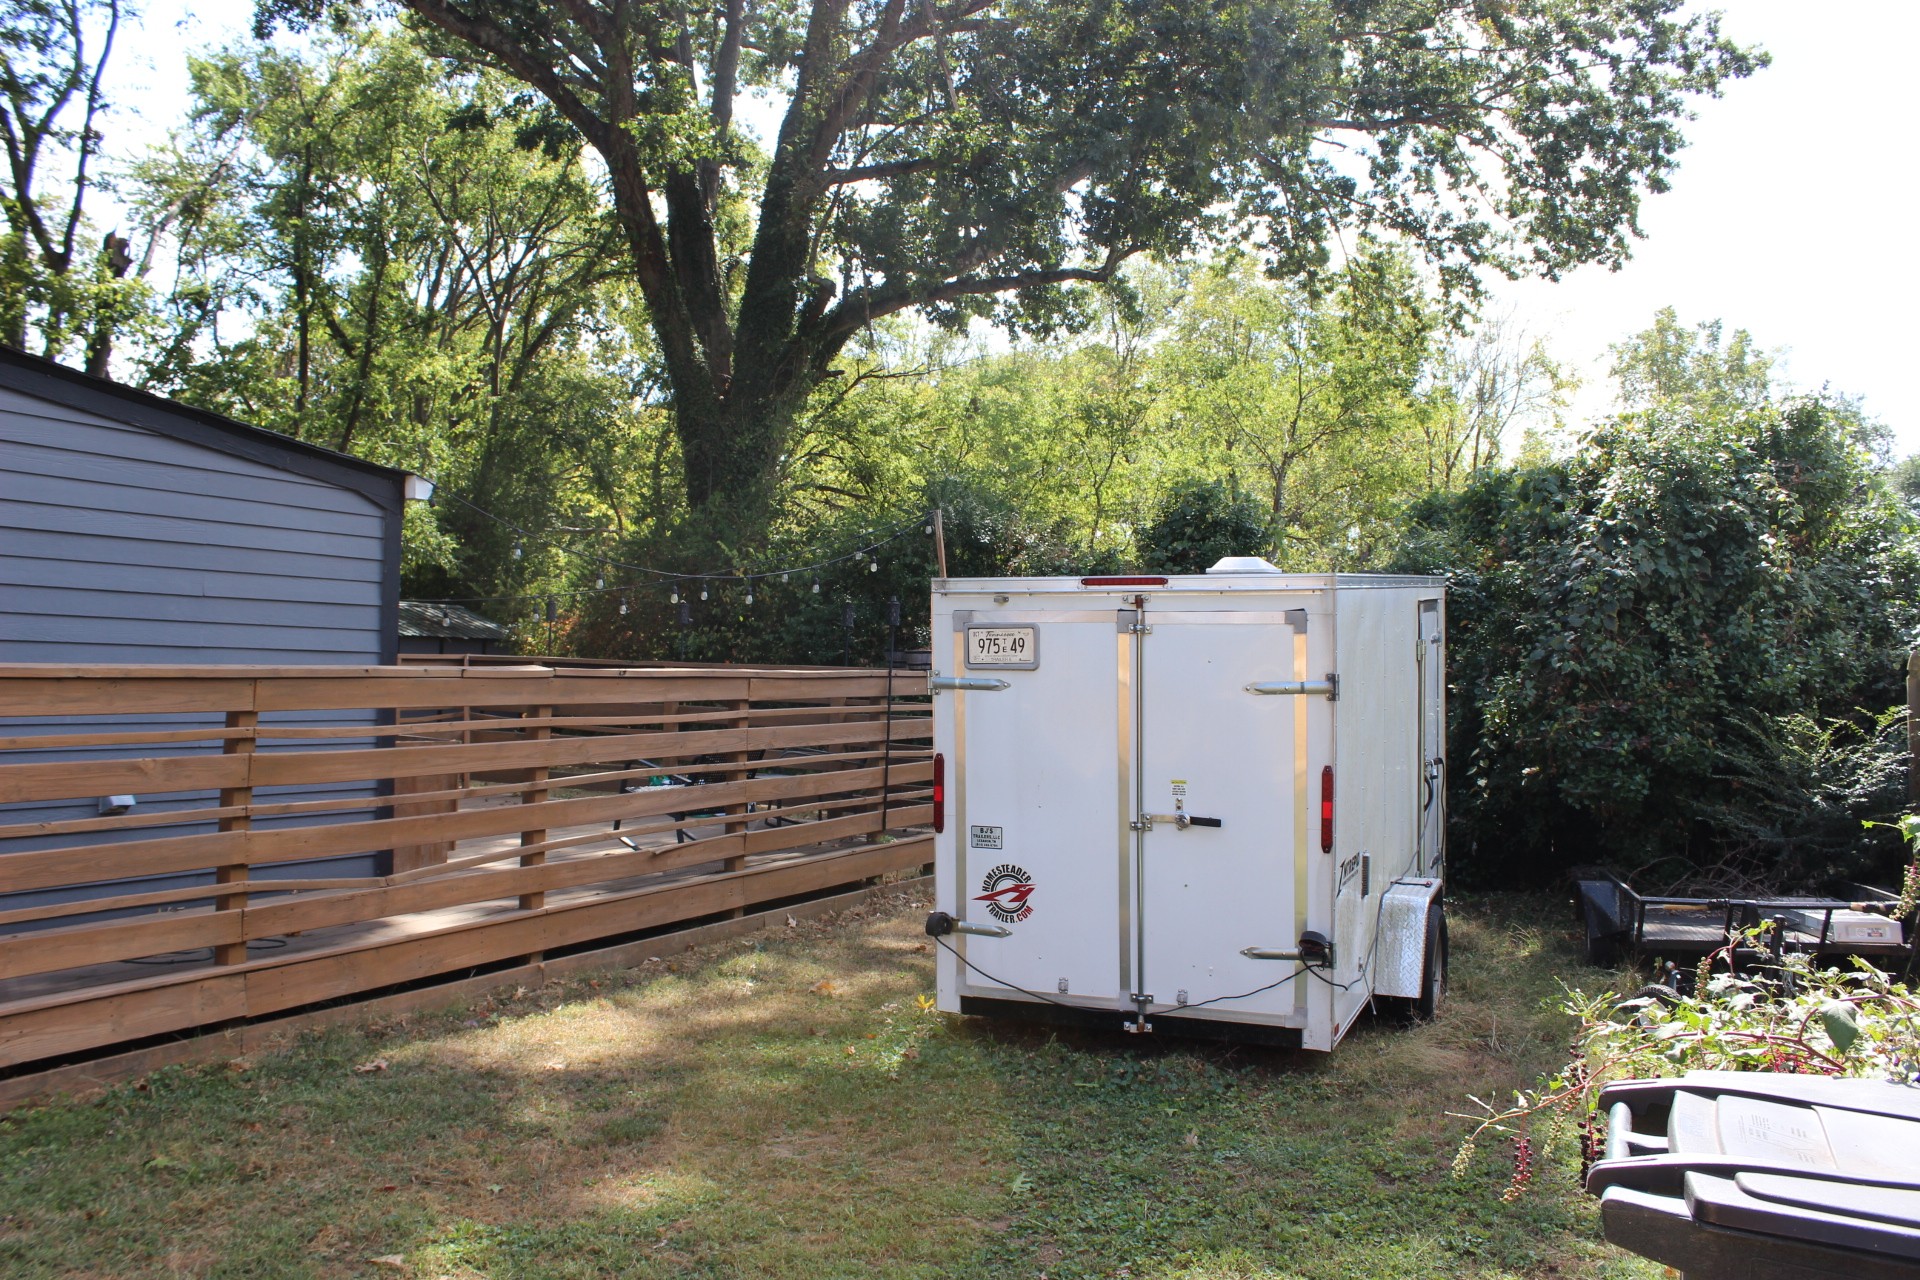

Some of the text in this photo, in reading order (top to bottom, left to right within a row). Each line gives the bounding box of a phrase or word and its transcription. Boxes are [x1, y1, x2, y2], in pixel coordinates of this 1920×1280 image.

[978, 638, 1000, 654] 975
[1010, 638, 1025, 654] 49
[982, 864, 1031, 892] HOMESTEADER
[986, 902, 1034, 923] TRAILER.COM
